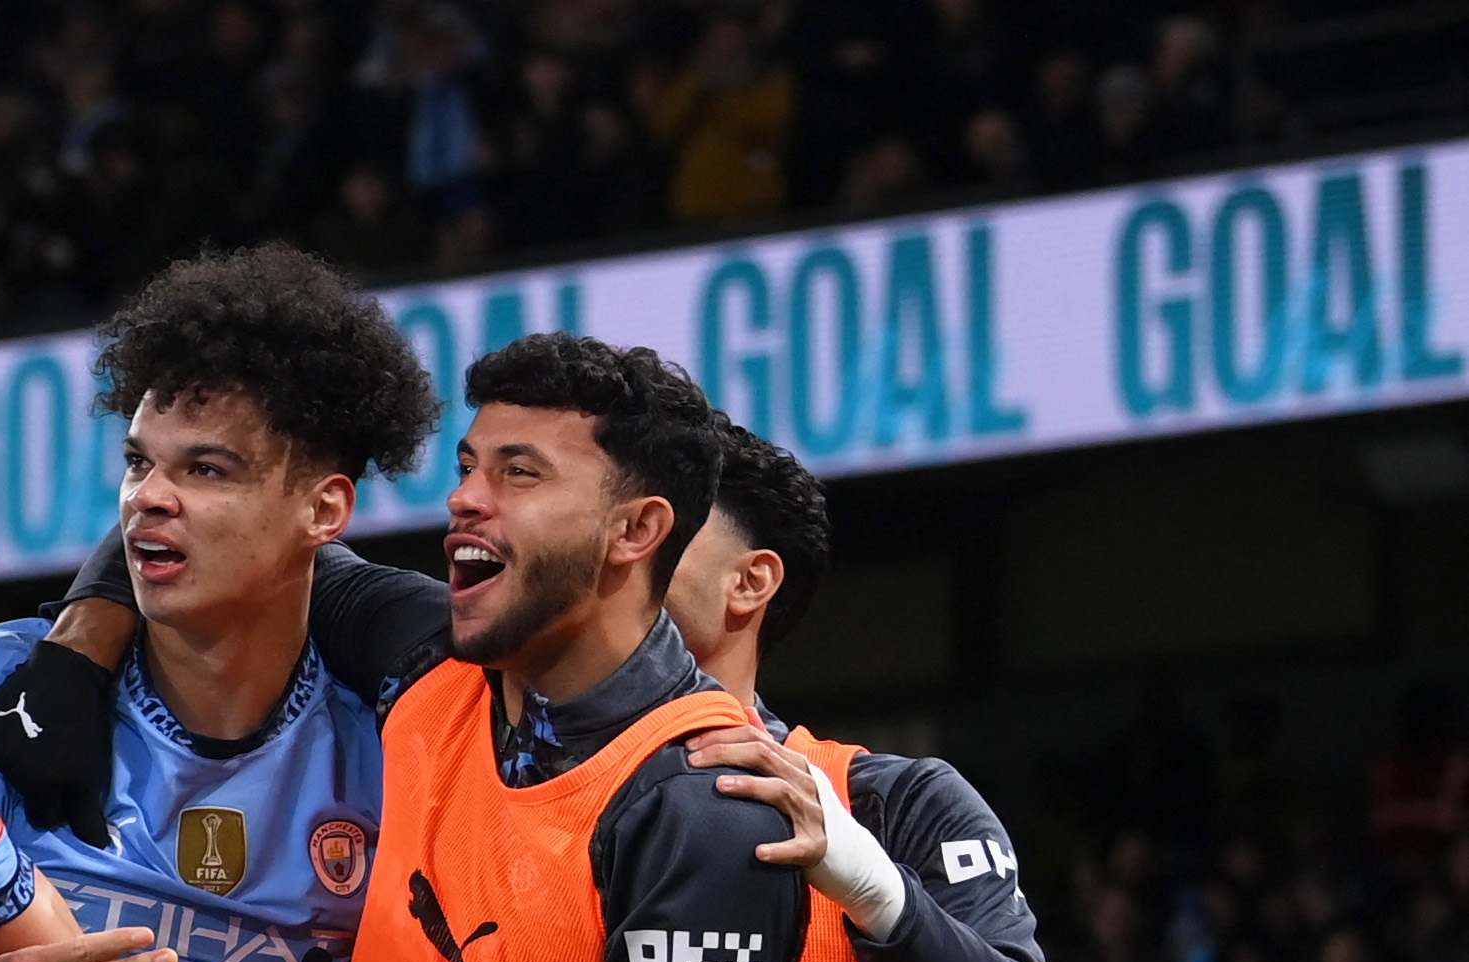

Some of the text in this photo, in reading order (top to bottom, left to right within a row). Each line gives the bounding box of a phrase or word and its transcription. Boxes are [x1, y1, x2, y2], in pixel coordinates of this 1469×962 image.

[699, 224, 1029, 456] GOAL
[1117, 163, 1466, 418] GOAL
[312, 823, 363, 848] MANCHESTER
[195, 867, 227, 880] FIFA
[334, 884, 351, 893] CITY
